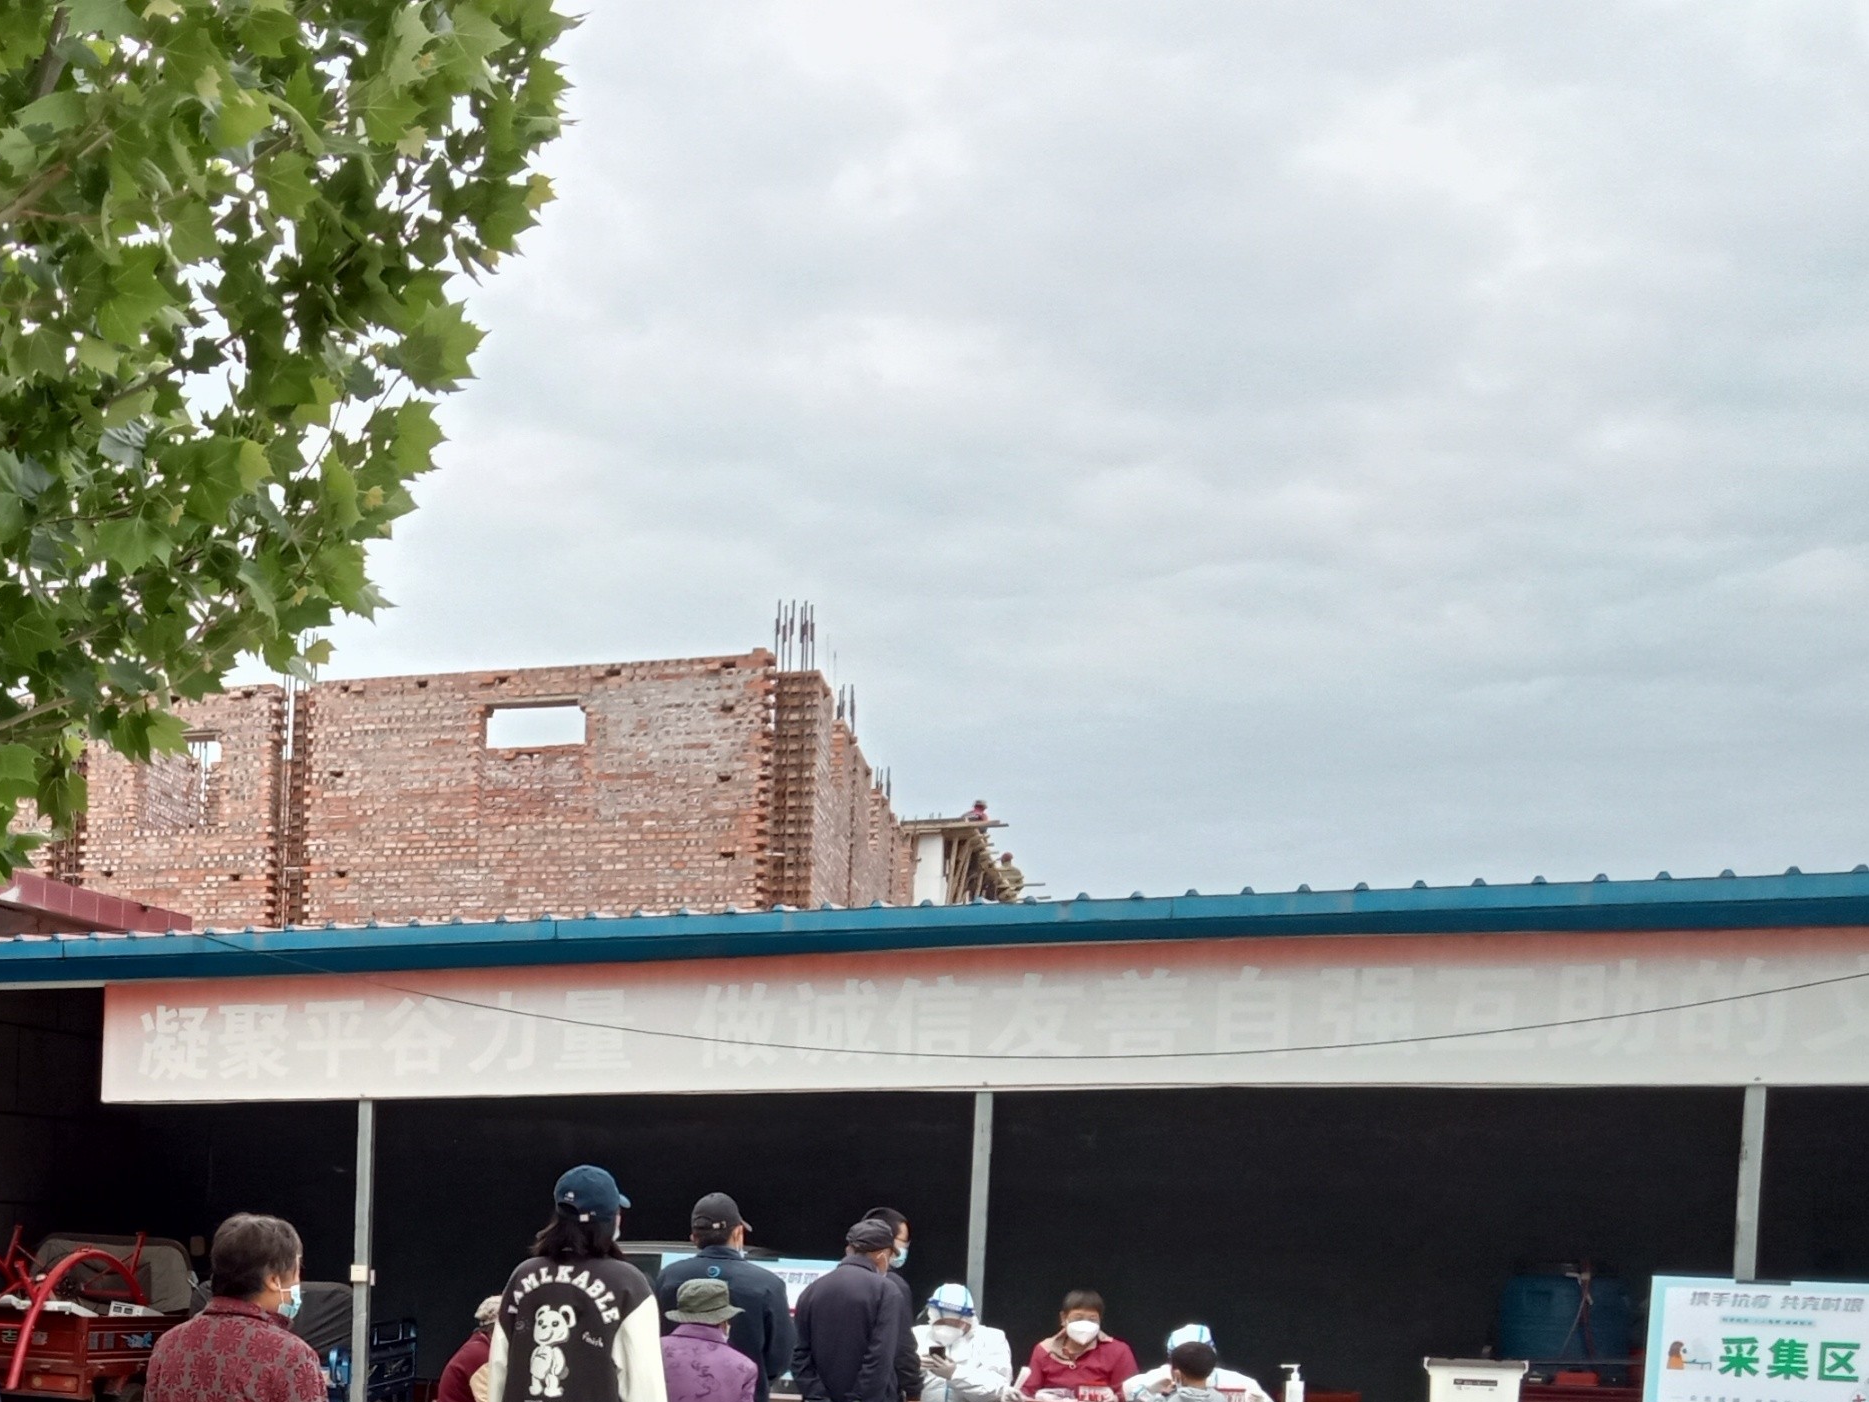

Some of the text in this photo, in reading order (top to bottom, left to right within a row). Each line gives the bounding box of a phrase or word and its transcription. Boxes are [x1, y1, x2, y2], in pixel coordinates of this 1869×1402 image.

[137, 989, 632, 1083] 凝聚平谷力量
[1689, 1291, 1865, 1313] 携手抗疫 共克时艰
[1718, 1336, 1861, 1383] 采集区
